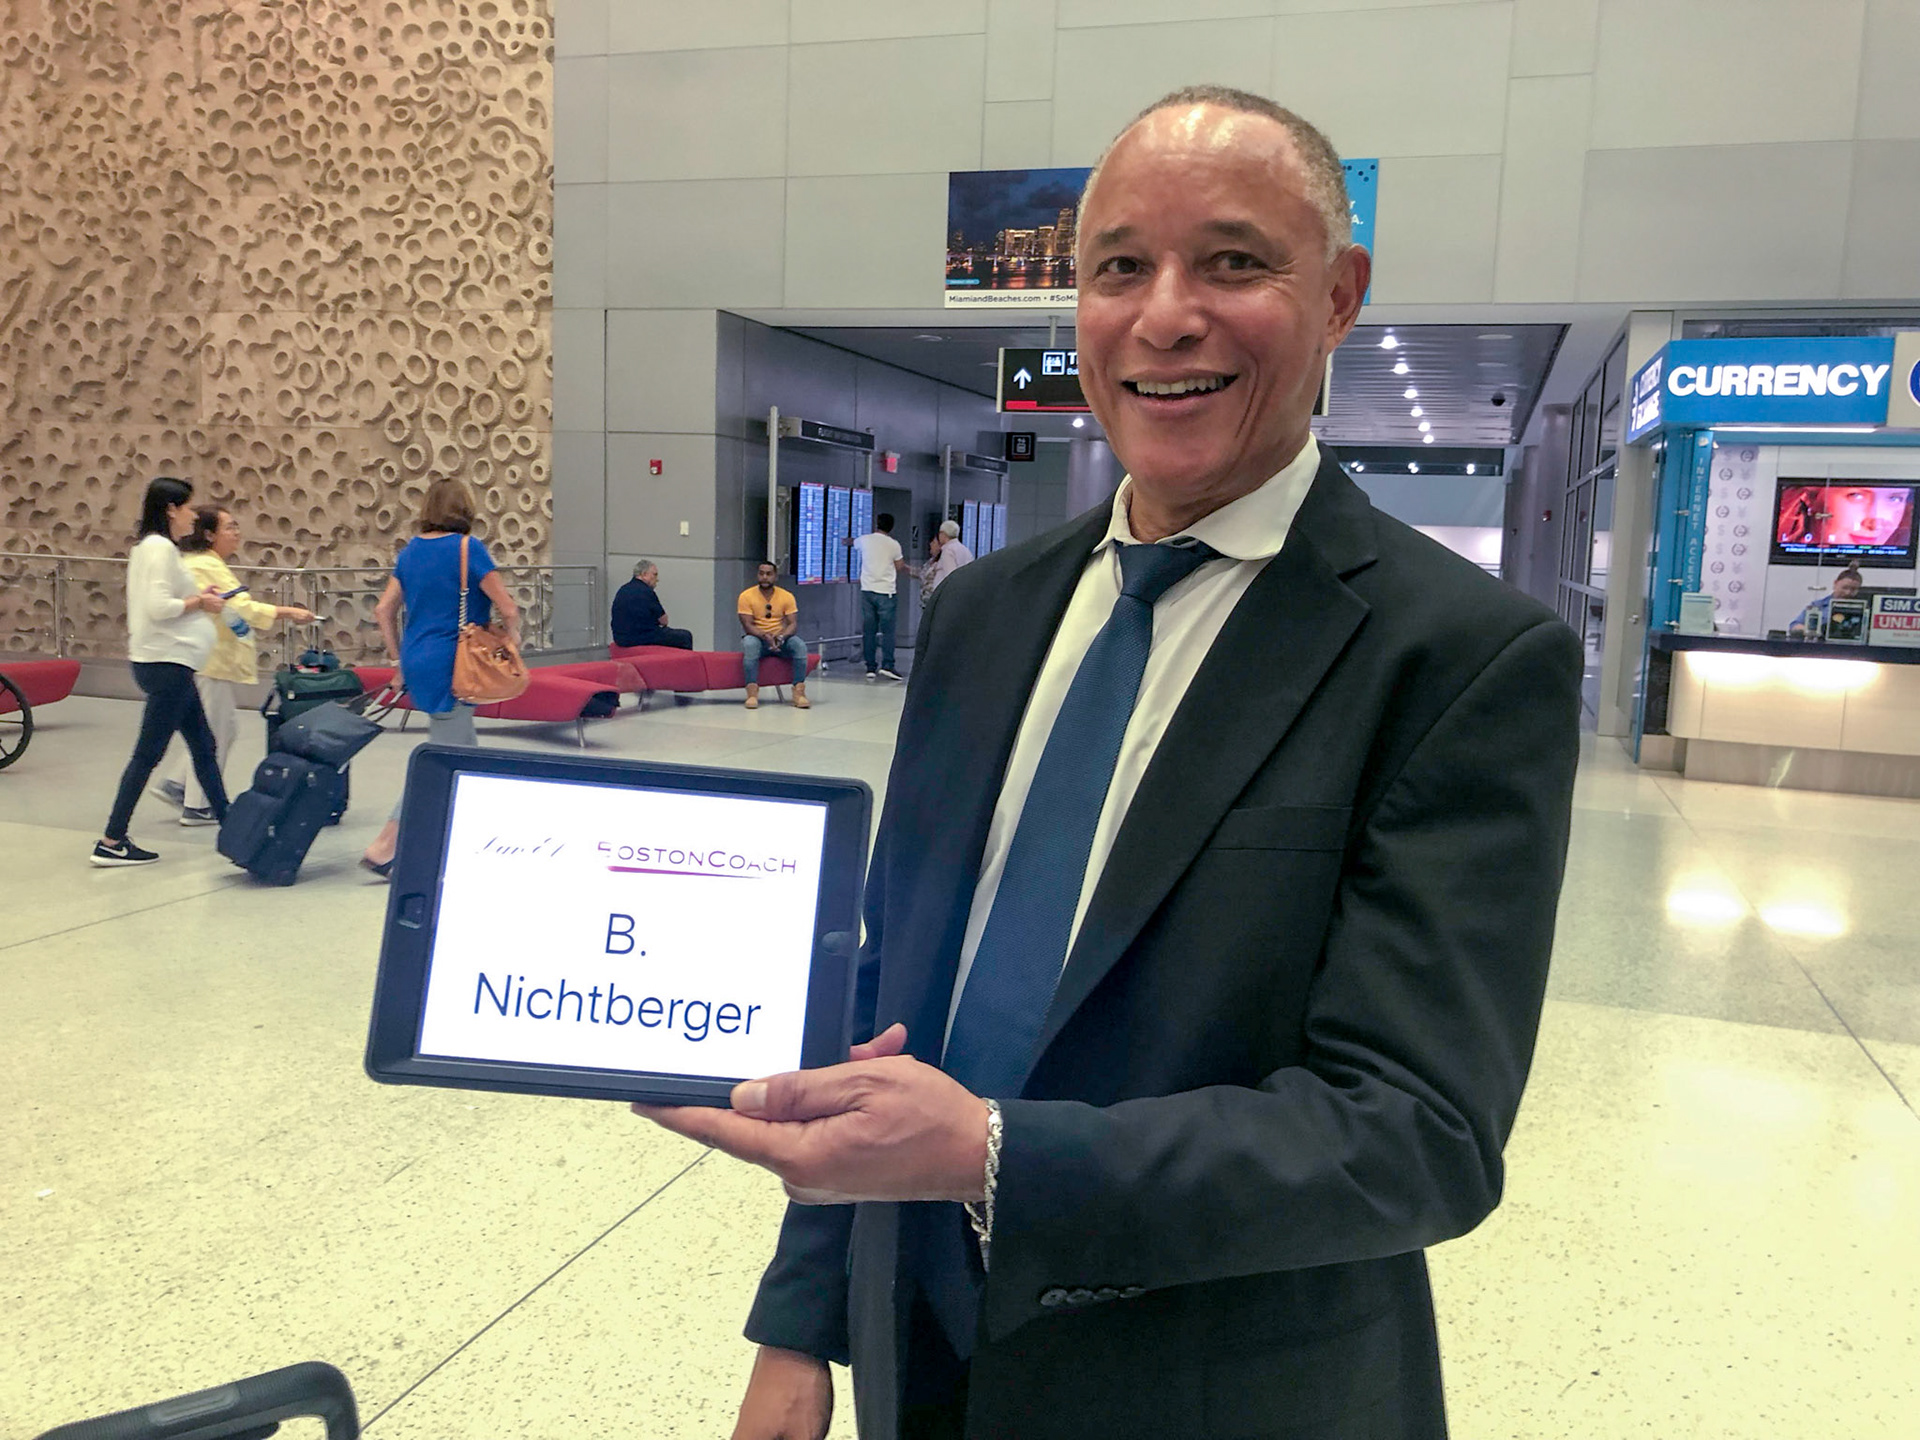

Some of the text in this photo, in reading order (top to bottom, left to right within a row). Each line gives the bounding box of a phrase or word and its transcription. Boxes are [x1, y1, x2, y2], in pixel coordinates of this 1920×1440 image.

[948, 294, 1042, 303] MiamiandBeaches.com
[1667, 364, 1890, 397] CURRENCY
[1883, 599, 1911, 611] SIM
[1879, 616, 1920, 630] UNLI
[604, 912, 647, 957] B.
[473, 971, 762, 1042] Nichtberger
